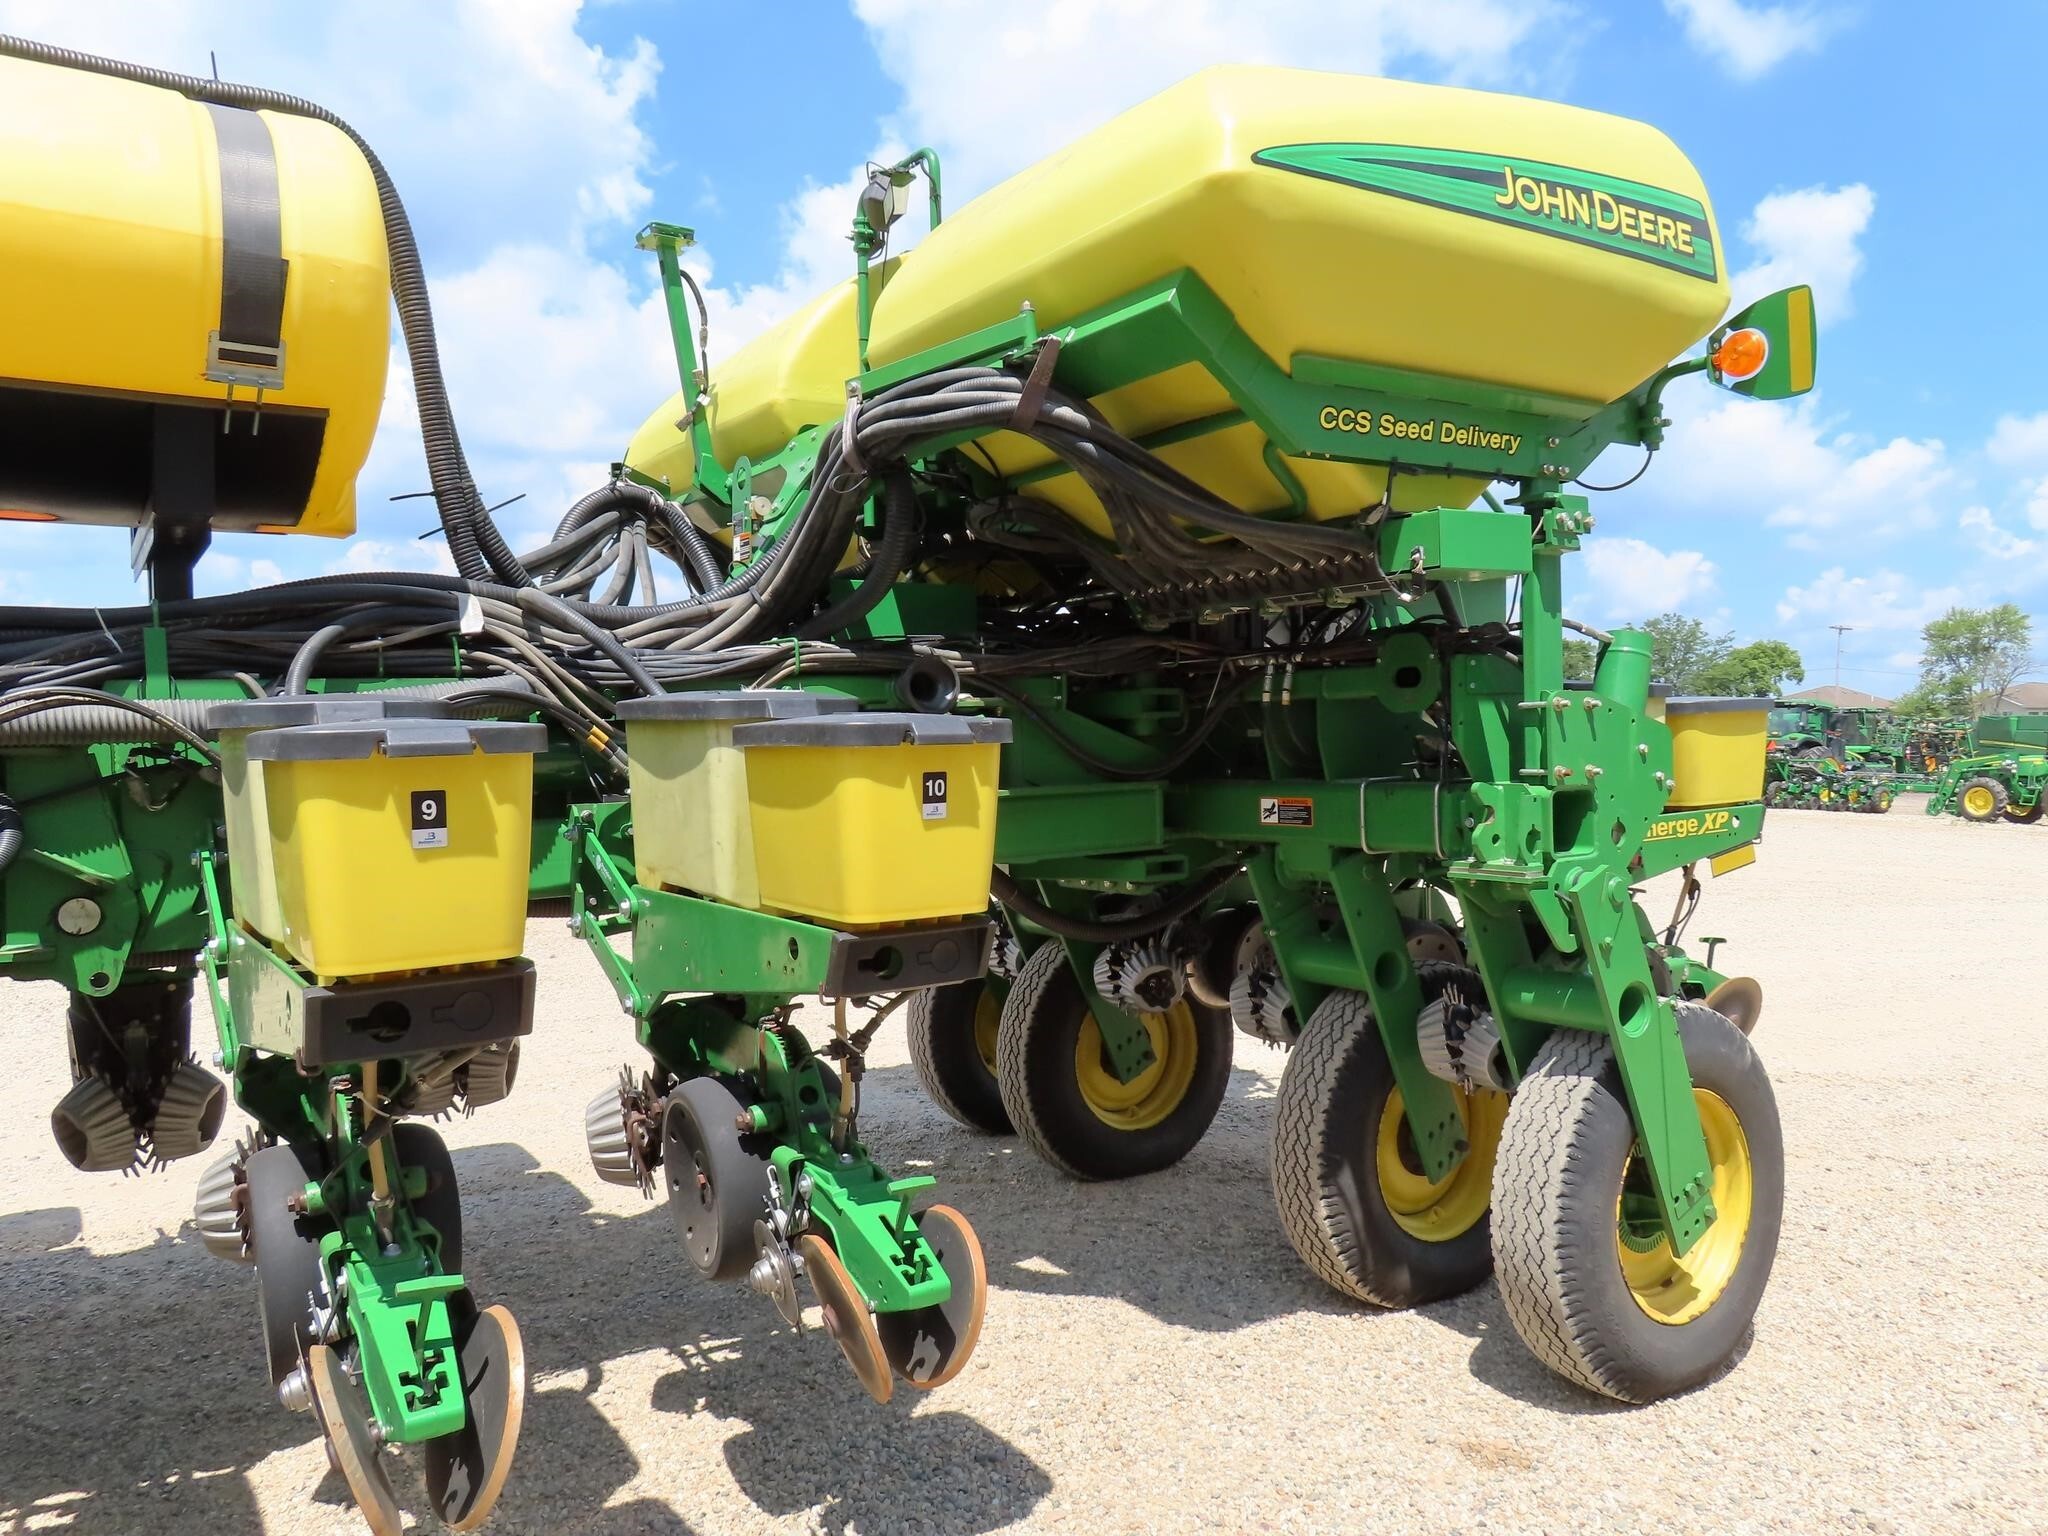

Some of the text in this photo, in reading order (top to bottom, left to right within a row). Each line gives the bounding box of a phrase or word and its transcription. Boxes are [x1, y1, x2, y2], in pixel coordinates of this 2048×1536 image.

[1496, 166, 1695, 254] JOHN DEERE
[1320, 406, 1521, 454] CCS Seed Delivery
[925, 779, 945, 797] 10
[421, 799, 437, 821] 9
[1698, 811, 1729, 835] XP
